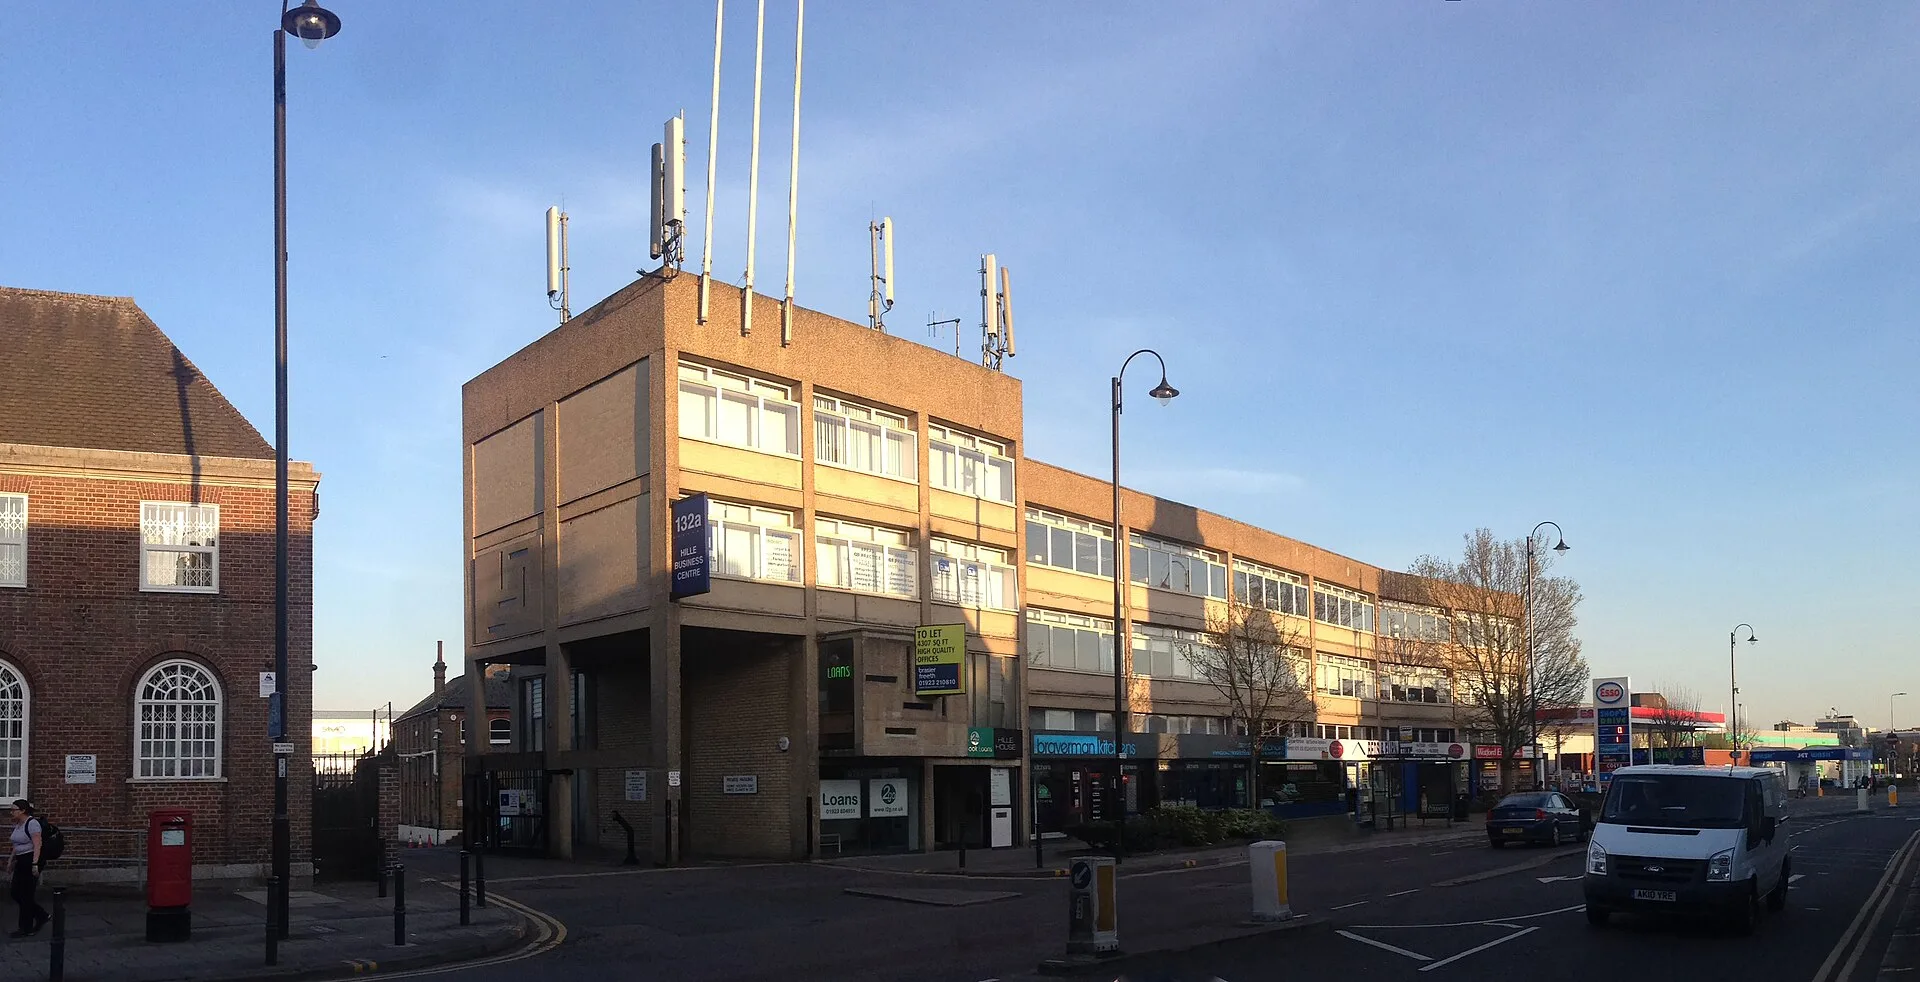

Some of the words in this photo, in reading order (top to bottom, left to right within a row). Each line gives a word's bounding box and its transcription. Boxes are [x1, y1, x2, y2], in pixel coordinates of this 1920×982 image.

[675, 512, 702, 532] 132a
[680, 545, 697, 557] HILLE
[674, 556, 704, 570] BUSINESS
[676, 568, 701, 580] CENTRE
[917, 630, 927, 639] TO
[929, 629, 942, 638] LET
[827, 666, 850, 679] LOANS
[1599, 688, 1620, 697] Esso
[1037, 739, 1097, 755] braverman
[822, 793, 858, 805] Loans
[1637, 890, 1655, 899] AK10
[1657, 891, 1673, 900] YRE
